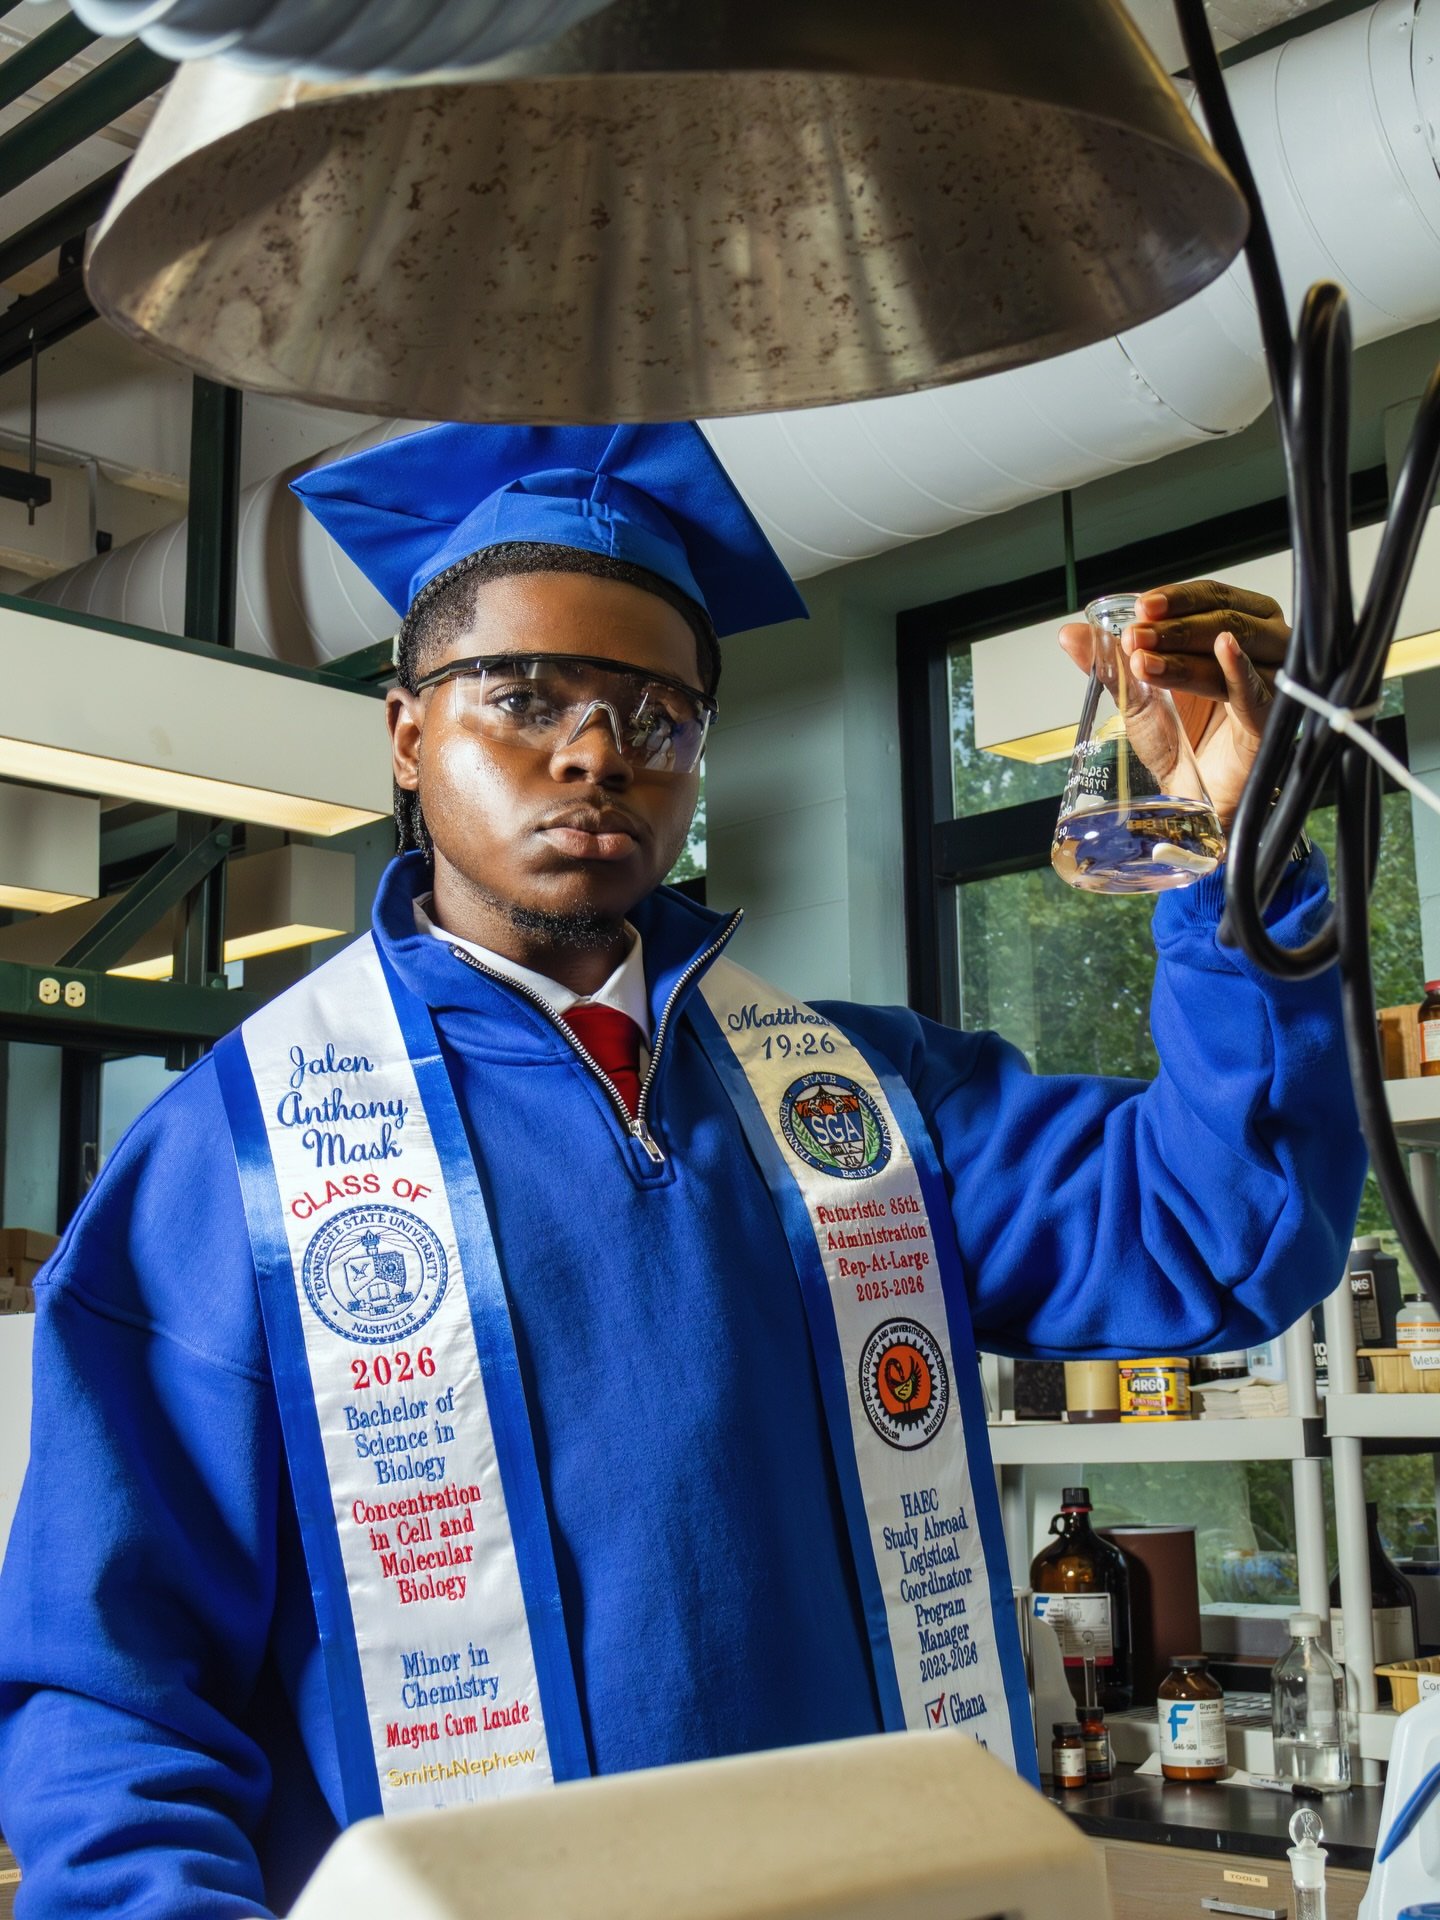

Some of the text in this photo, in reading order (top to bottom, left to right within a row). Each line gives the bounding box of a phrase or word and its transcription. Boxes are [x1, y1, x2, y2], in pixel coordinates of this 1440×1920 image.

[761, 1032, 836, 1060] 19:26
[289, 1043, 375, 1089] Jalen
[277, 1087, 408, 1129] Anthony
[801, 1074, 837, 1086] STATE
[858, 1090, 893, 1152] UNIVERSITY
[302, 1122, 403, 1168] Mask
[811, 1112, 864, 1145] SGA
[291, 1173, 432, 1219] CLASS OF
[816, 1195, 921, 1225] Futuristic 85th
[827, 1221, 928, 1252] Administration
[313, 1213, 438, 1301] TENNESSEE STATE UNIVERSITY
[839, 1250, 929, 1277] Rep-At-Large
[857, 1275, 925, 1301] 2025-2026
[352, 1312, 417, 1335] NASHVILLE
[878, 1330, 889, 1342] AND
[350, 1346, 436, 1391] 2026
[864, 1339, 879, 1375] COLLEGES
[863, 1376, 873, 1402] BLACK
[1131, 1378, 1166, 1392] ARGO
[343, 1387, 456, 1432] Bachelor of
[354, 1421, 455, 1459] Science in
[375, 1454, 446, 1486] Biology
[352, 1482, 482, 1524] Concentration
[901, 1487, 939, 1519] HAEC
[370, 1509, 475, 1551] in Cell and
[883, 1507, 969, 1550] Study Abroad
[381, 1542, 475, 1578] Molecular
[901, 1536, 960, 1575] Logistical
[397, 1572, 467, 1604] Biology
[900, 1565, 972, 1603] Coordinator
[915, 1597, 966, 1628] Program
[918, 1622, 970, 1655] Manager
[401, 1642, 490, 1680] Minor in
[920, 1645, 978, 1682] 2023-2026
[402, 1673, 499, 1711] Chemistry
[950, 1692, 987, 1724] Ghana
[386, 1700, 530, 1749] Magna Cum Laude
[1230, 1873, 1261, 1883] TOOLS
